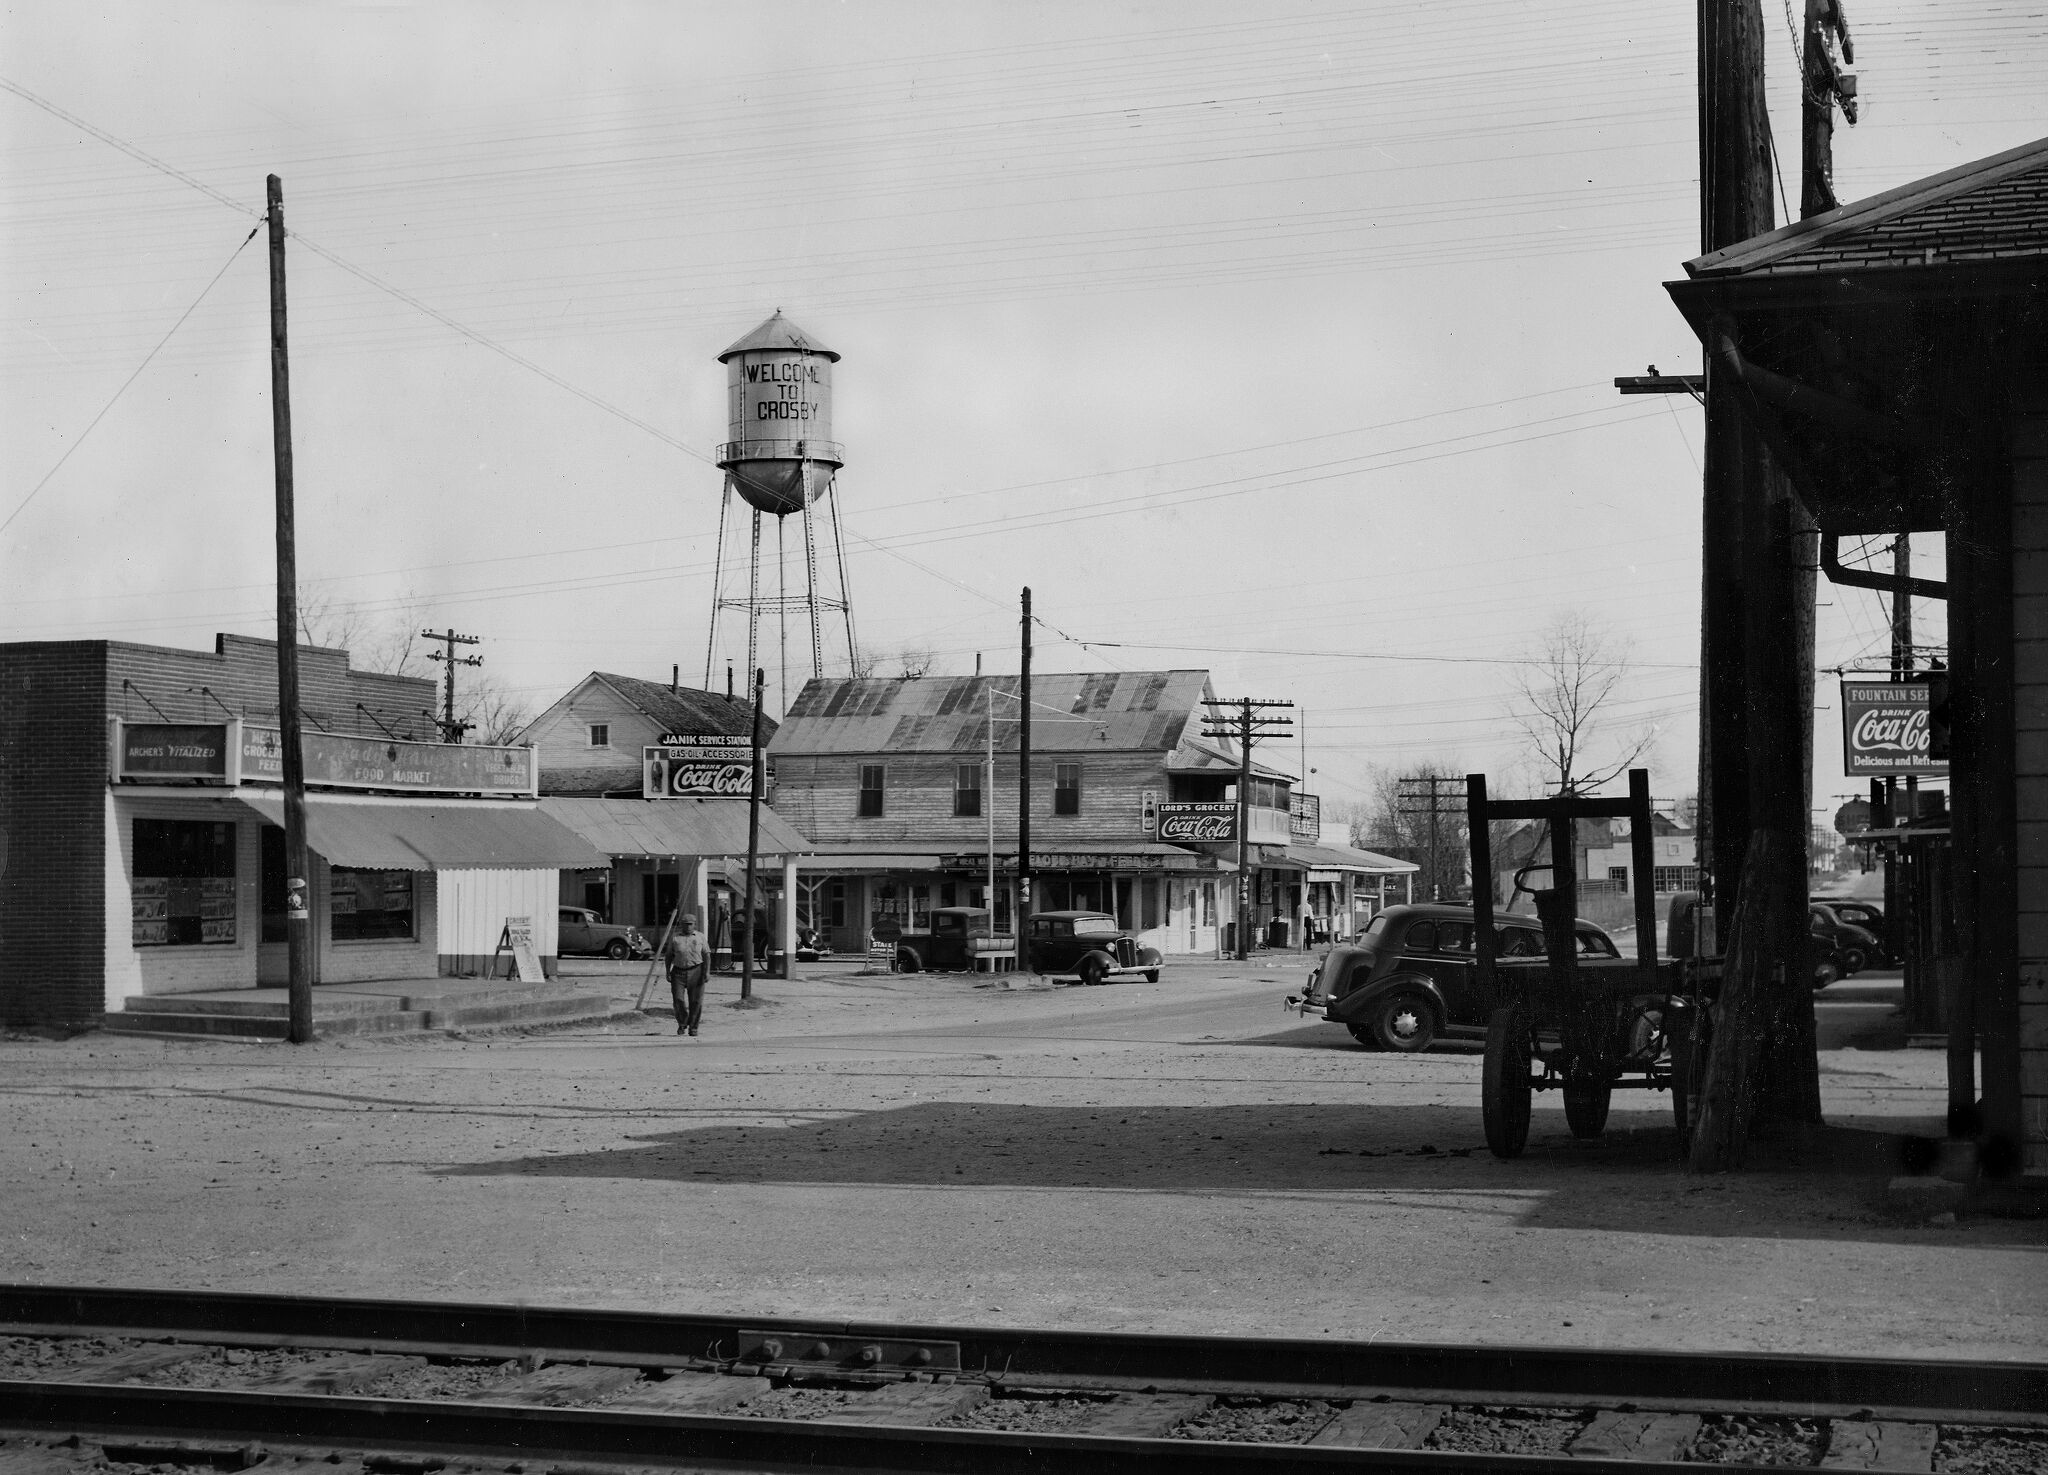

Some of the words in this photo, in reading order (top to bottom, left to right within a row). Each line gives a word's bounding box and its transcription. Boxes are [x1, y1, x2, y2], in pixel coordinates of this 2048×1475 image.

[746, 363, 819, 384] WELCOME
[777, 384, 798, 399] TO
[757, 401, 818, 420] CROSBY
[1852, 689, 1906, 701] FOUNTAIN
[1852, 709, 1930, 751] Coca-Co
[662, 735, 697, 744] JANIK
[698, 735, 726, 745] SERVICE
[726, 736, 752, 745] STATION
[128, 746, 164, 757] ARCHER'S
[168, 745, 216, 757] VITALIZED
[243, 744, 283, 759] GROCERI
[493, 750, 520, 762] FLUR
[702, 750, 753, 759] ACCESSORIE
[1854, 755, 1893, 766] Delicious
[1894, 755, 1911, 766] and
[354, 768, 384, 781] FOOD
[392, 769, 431, 784] MARKET
[493, 774, 520, 785] DRUGS
[673, 763, 753, 793] Coca-Cola
[1161, 815, 1234, 838] Coca-Cola
